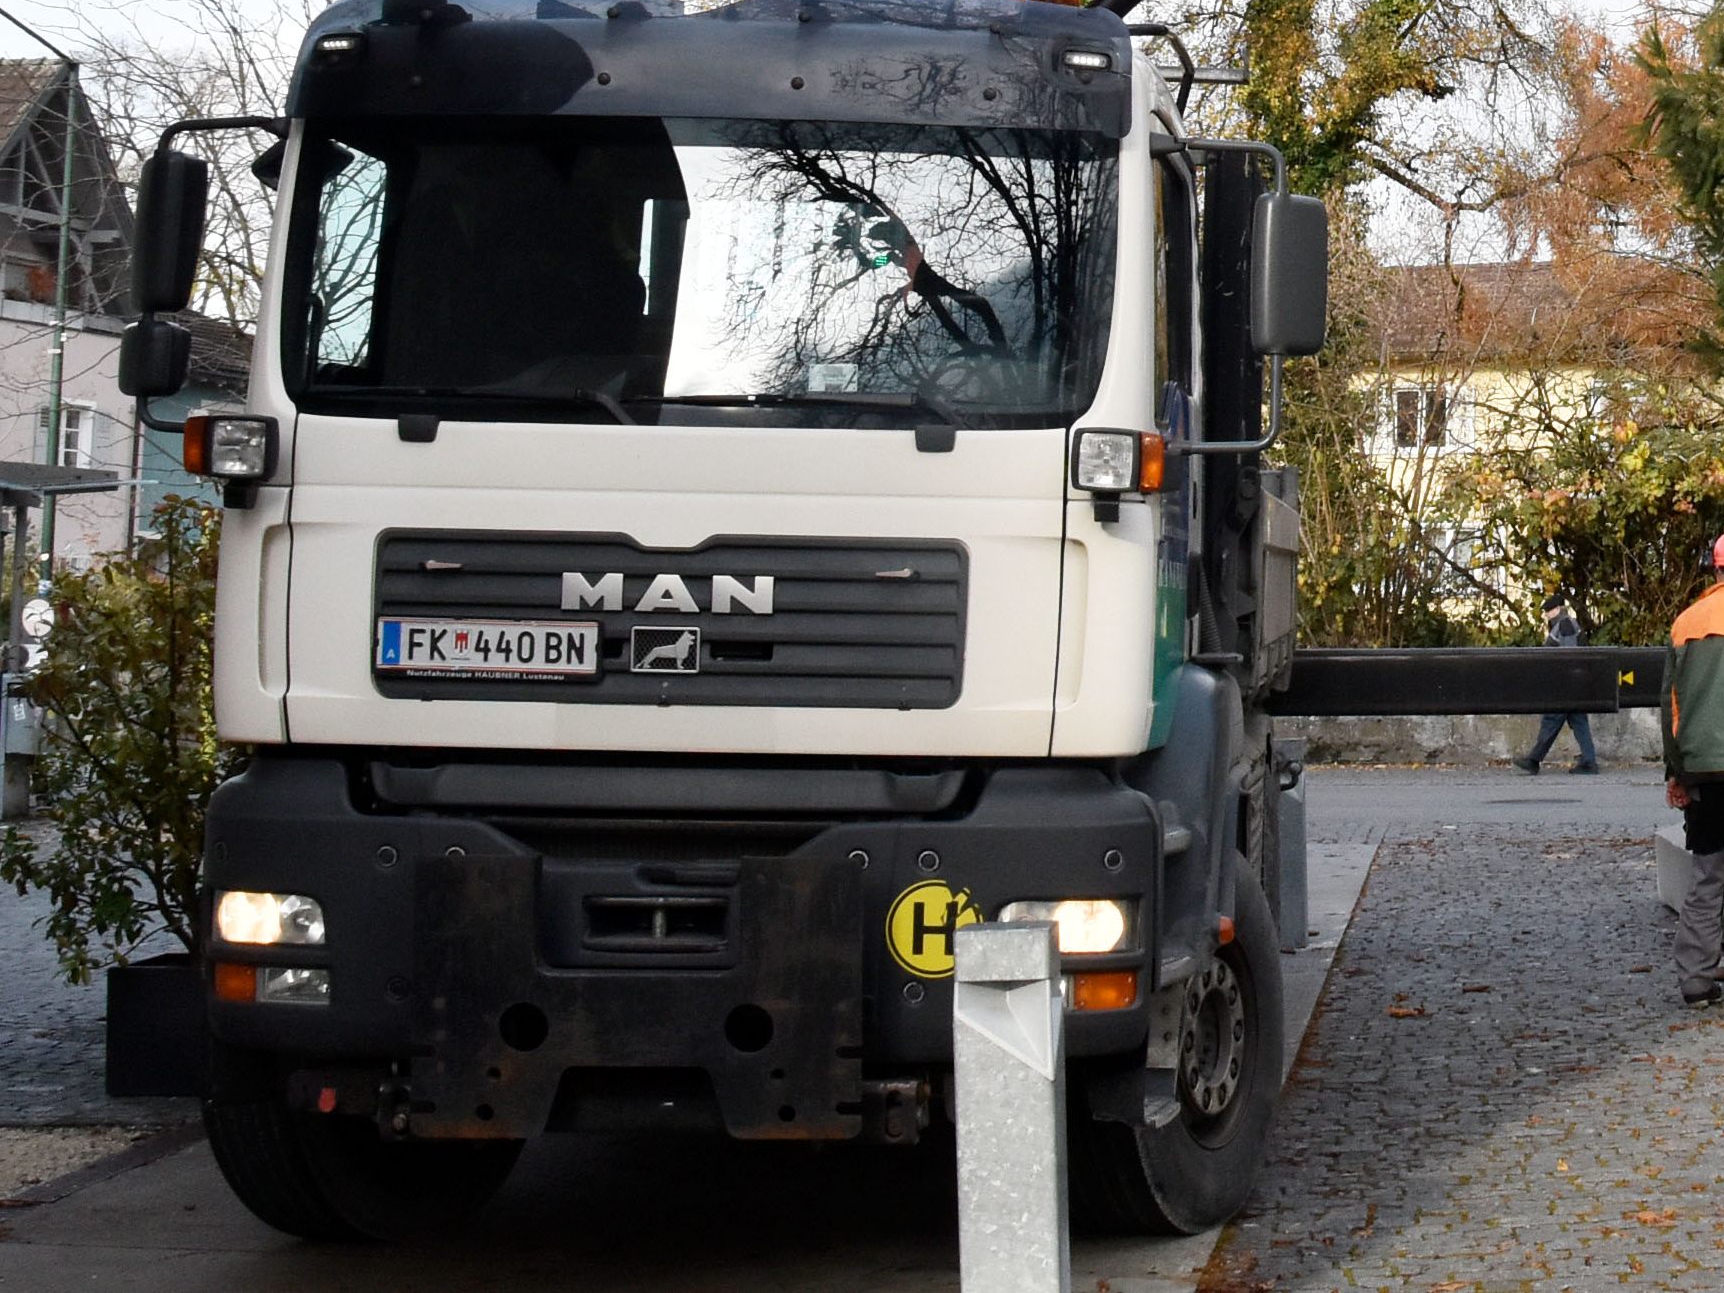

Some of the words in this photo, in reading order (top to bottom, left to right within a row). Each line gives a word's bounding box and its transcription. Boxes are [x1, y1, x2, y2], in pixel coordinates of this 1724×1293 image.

[561, 571, 774, 615] MAN
[407, 628, 448, 661] FK
[474, 630, 536, 664] 440
[544, 631, 585, 665] BN
[405, 669, 473, 679] Nutzfahrzeuge
[522, 671, 565, 681] Lustenau
